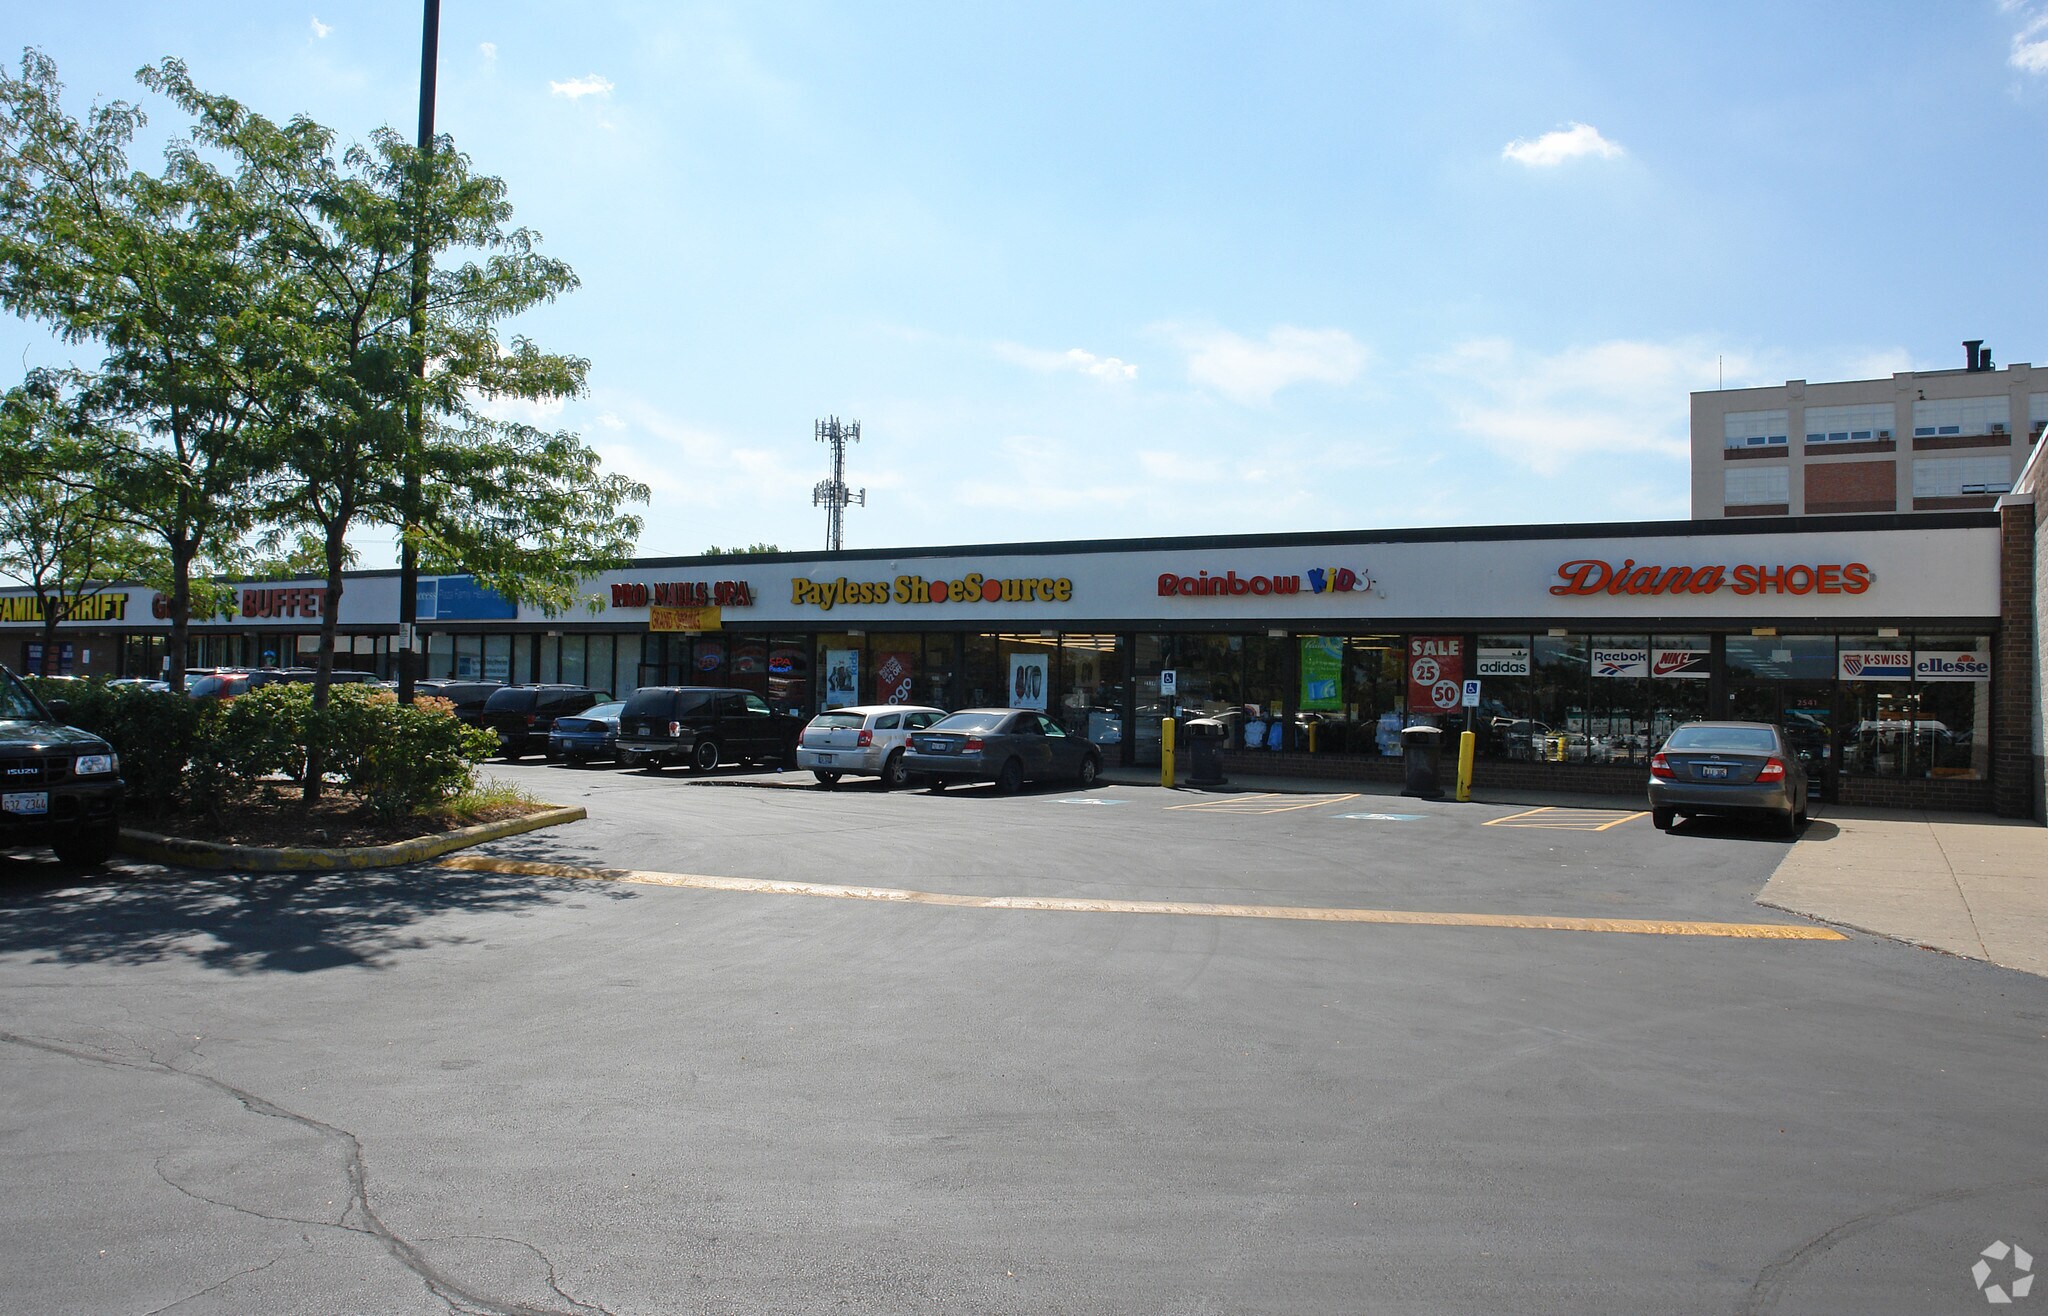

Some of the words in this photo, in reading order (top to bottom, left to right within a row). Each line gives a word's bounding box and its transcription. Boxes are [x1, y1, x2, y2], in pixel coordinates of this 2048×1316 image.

[1158, 570, 1300, 596] Rainbow
[1549, 559, 1726, 595] Diana
[1731, 563, 1870, 595] SHOES
[611, 583, 648, 608] PRO
[654, 582, 708, 606] NAILS
[713, 580, 753, 606] SPA
[791, 577, 889, 610] Payless
[893, 573, 1072, 604] ShoeSource
[242, 588, 327, 618] BUFFET
[1412, 641, 1459, 656] SALE
[1594, 652, 1647, 662] Reebok
[769, 658, 791, 666] SPA
[1480, 661, 1527, 673] adidas
[1660, 652, 1688, 665] NIKE
[1917, 653, 1988, 672] ellesse
[1416, 665, 1435, 680] 25
[888, 678, 912, 705] ogo
[1434, 686, 1455, 702] 50
